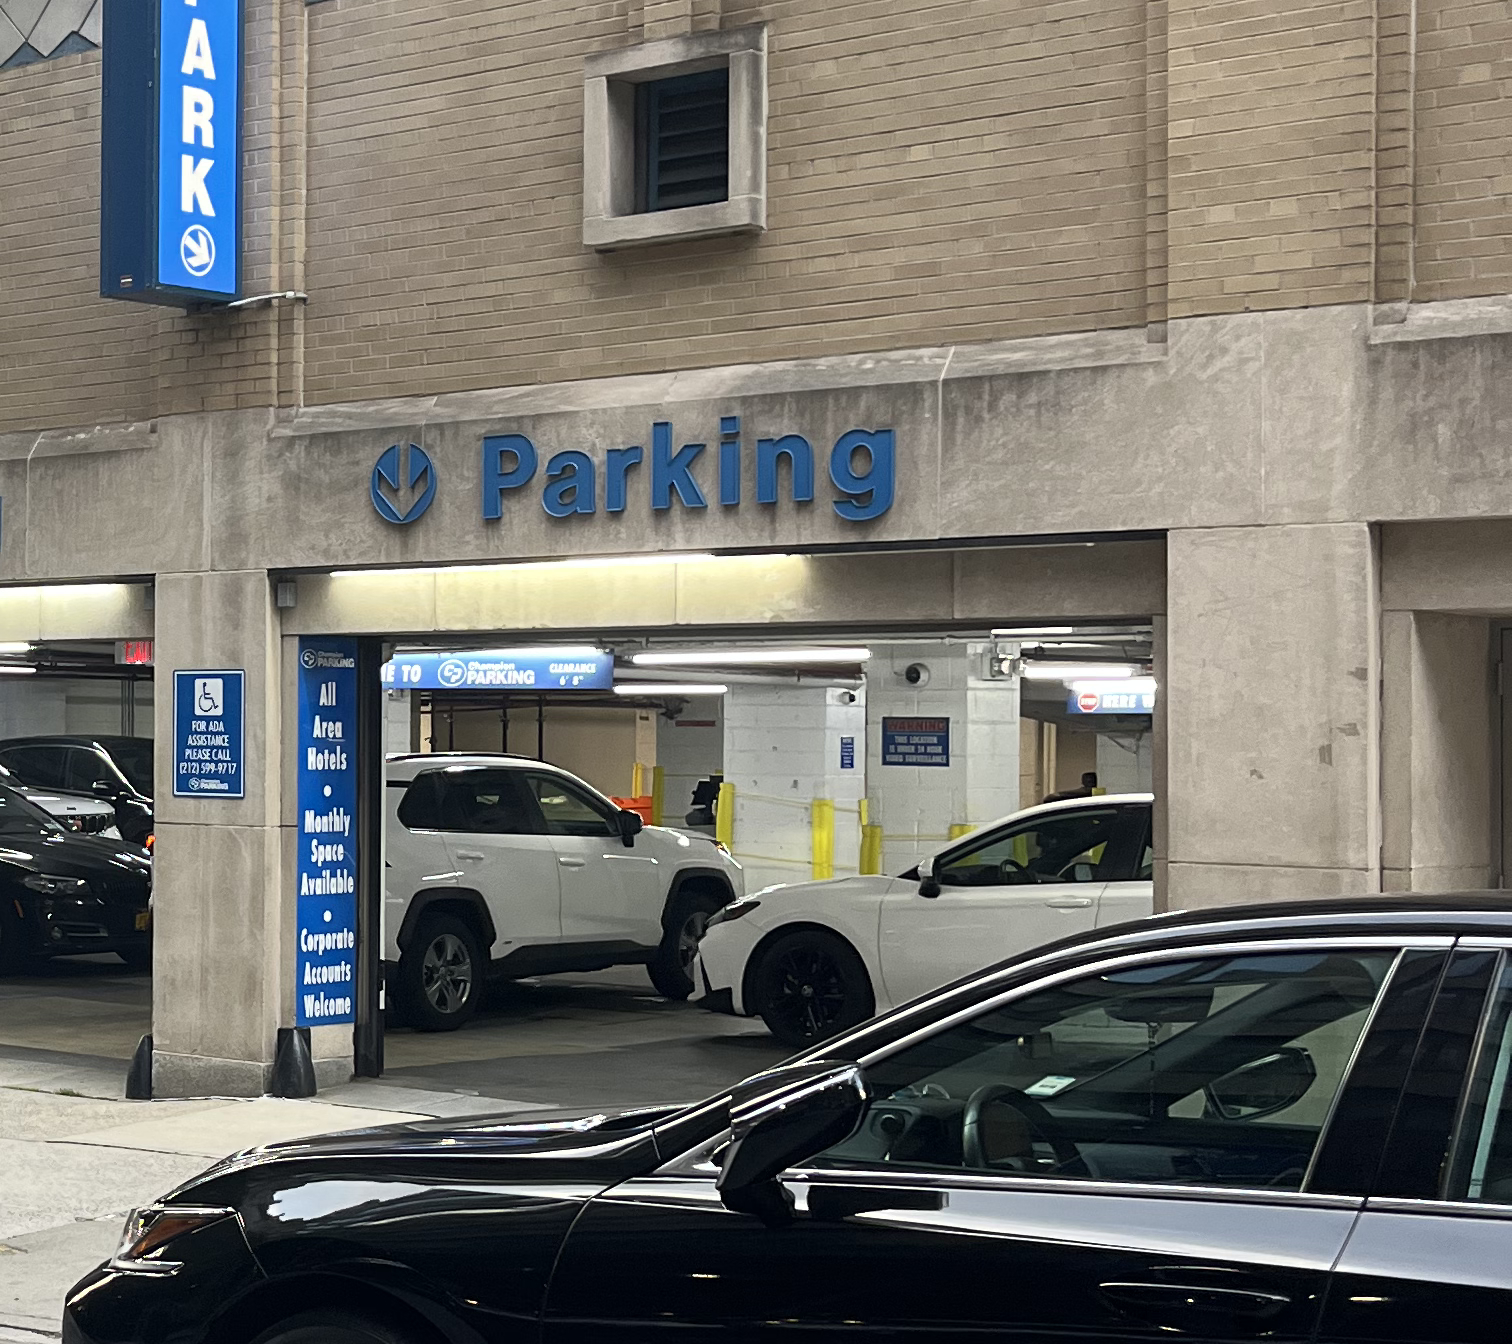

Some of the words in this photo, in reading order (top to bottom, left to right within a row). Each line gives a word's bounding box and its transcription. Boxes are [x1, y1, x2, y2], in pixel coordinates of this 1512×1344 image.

[482, 415, 896, 522] Parking
[401, 664, 422, 683] TO
[467, 661, 515, 671] Champion
[549, 663, 596, 674] CLEARANCE
[467, 669, 535, 685] PARKING
[320, 682, 336, 706] All
[1102, 694, 1137, 708] HERE
[192, 721, 206, 732] FOR
[208, 721, 225, 732] ADA
[313, 715, 342, 738] Area
[887, 720, 946, 732] WARNING
[187, 734, 230, 747] ASSISTANCE
[185, 748, 210, 761] PLEASE
[212, 748, 231, 761] CALL
[308, 746, 347, 771] Hotels
[179, 762, 199, 775] (212)
[305, 807, 350, 836] Monthly
[311, 839, 344, 866] Space
[301, 869, 354, 895] Available
[301, 928, 354, 955] Corporate
[304, 961, 351, 985] Accounts
[304, 992, 351, 1018] Welcome
